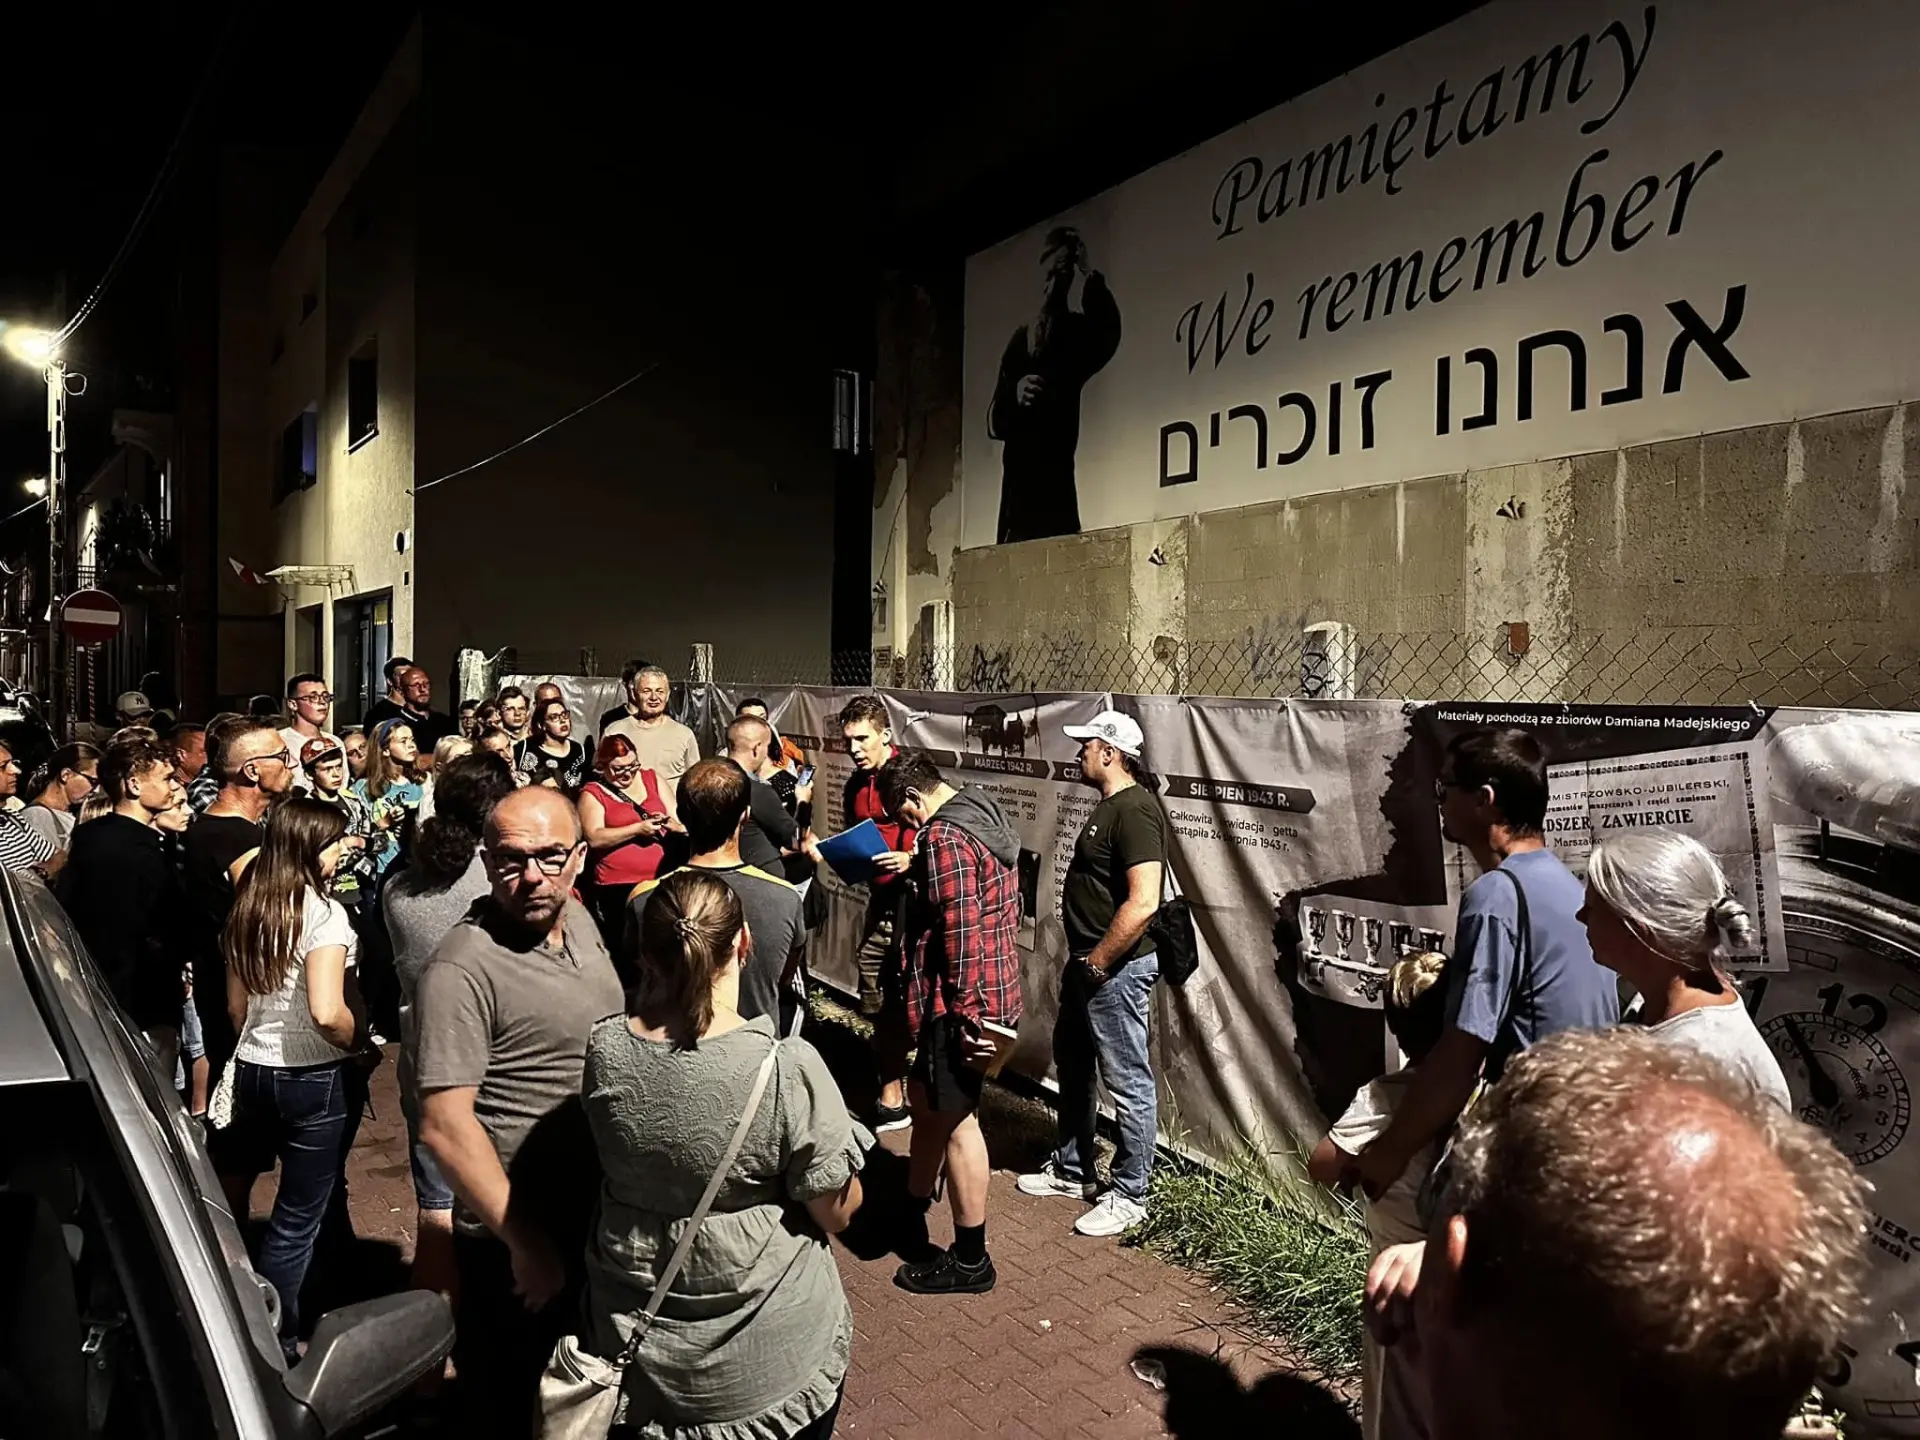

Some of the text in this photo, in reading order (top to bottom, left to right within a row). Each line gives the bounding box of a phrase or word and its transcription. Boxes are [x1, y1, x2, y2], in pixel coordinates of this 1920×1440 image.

[1211, 4, 1657, 241] Pamiętamy
[1175, 149, 1724, 375] We remember
[1159, 283, 1752, 489] אנחנו זוכרים
[1437, 710, 1750, 732] Materiały pochodzą ze zbiorów Damiana Madejskiego
[974, 757, 1034, 773] MARZEC 1942 R.
[1190, 781, 1290, 807] SIERPIEŃ 1943 R.
[1548, 779, 1730, 801] MISTRZOWSKO-JUBILERSKI,
[1169, 810, 1213, 825] Całkowita
[1273, 825, 1298, 838] getta
[1542, 809, 1694, 832] DSZER, ZAWIERCIE
[1170, 824, 1209, 839] nastąpiła
[1211, 829, 1221, 840] 24
[1260, 837, 1281, 850] 1943
[1282, 842, 1290, 852] r.
[1828, 1031, 1851, 1049] 12
[1864, 1058, 1874, 1072] 1
[1873, 1084, 1889, 1099] 2
[1874, 1110, 1889, 1126] 3
